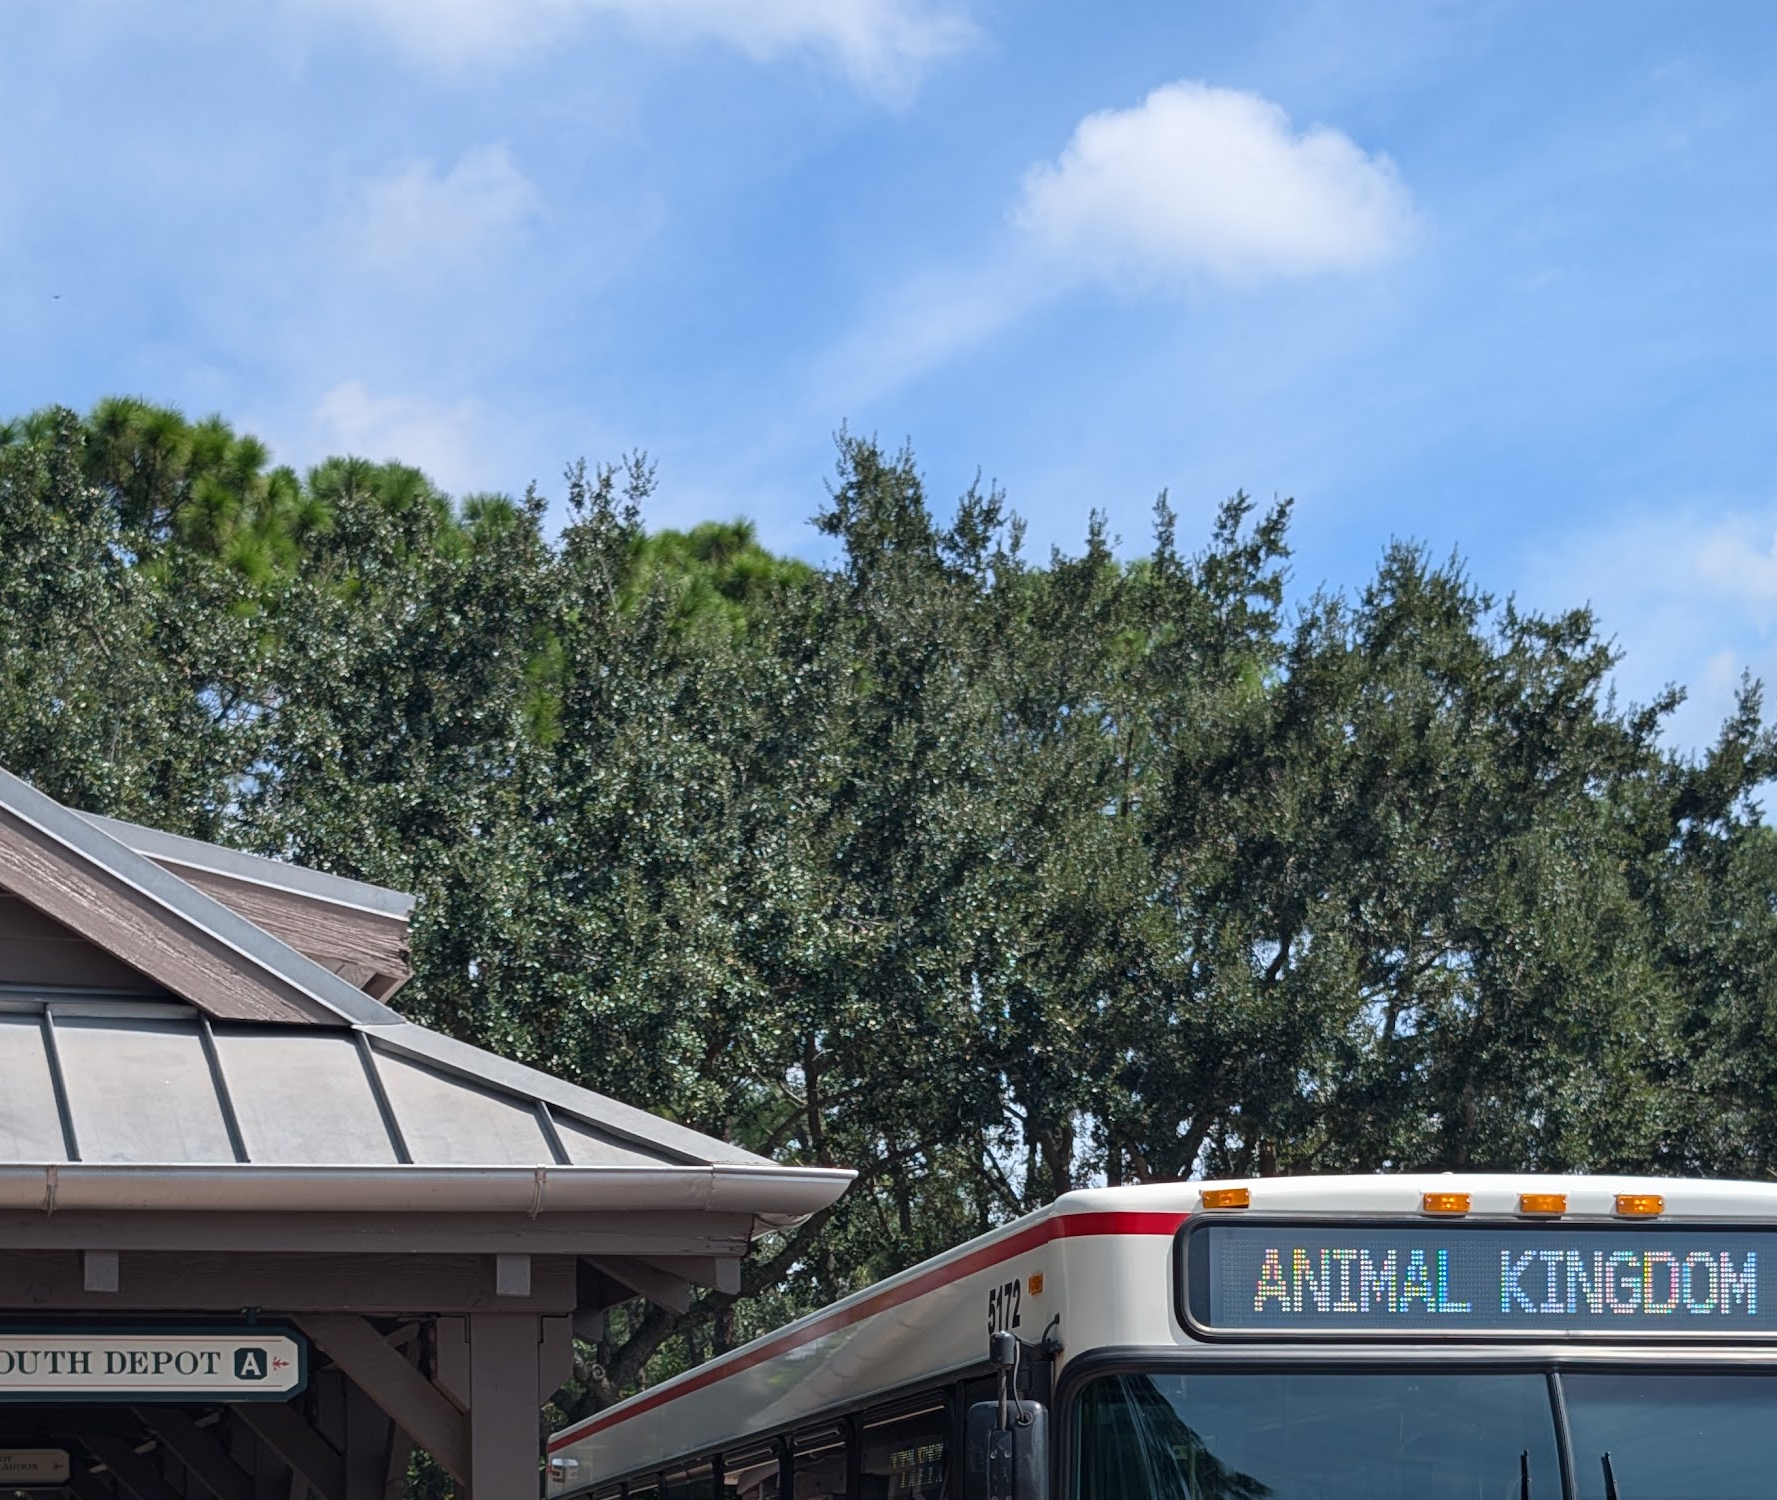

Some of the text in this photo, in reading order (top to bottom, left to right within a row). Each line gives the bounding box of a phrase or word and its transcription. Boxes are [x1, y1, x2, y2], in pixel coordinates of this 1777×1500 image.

[987, 1278, 1021, 1335] 5172
[1253, 1248, 1472, 1313] ANIMAL
[1500, 1249, 1757, 1315] KINGDOM
[103, 1350, 222, 1376] DEPOT
[240, 1351, 262, 1377] A
